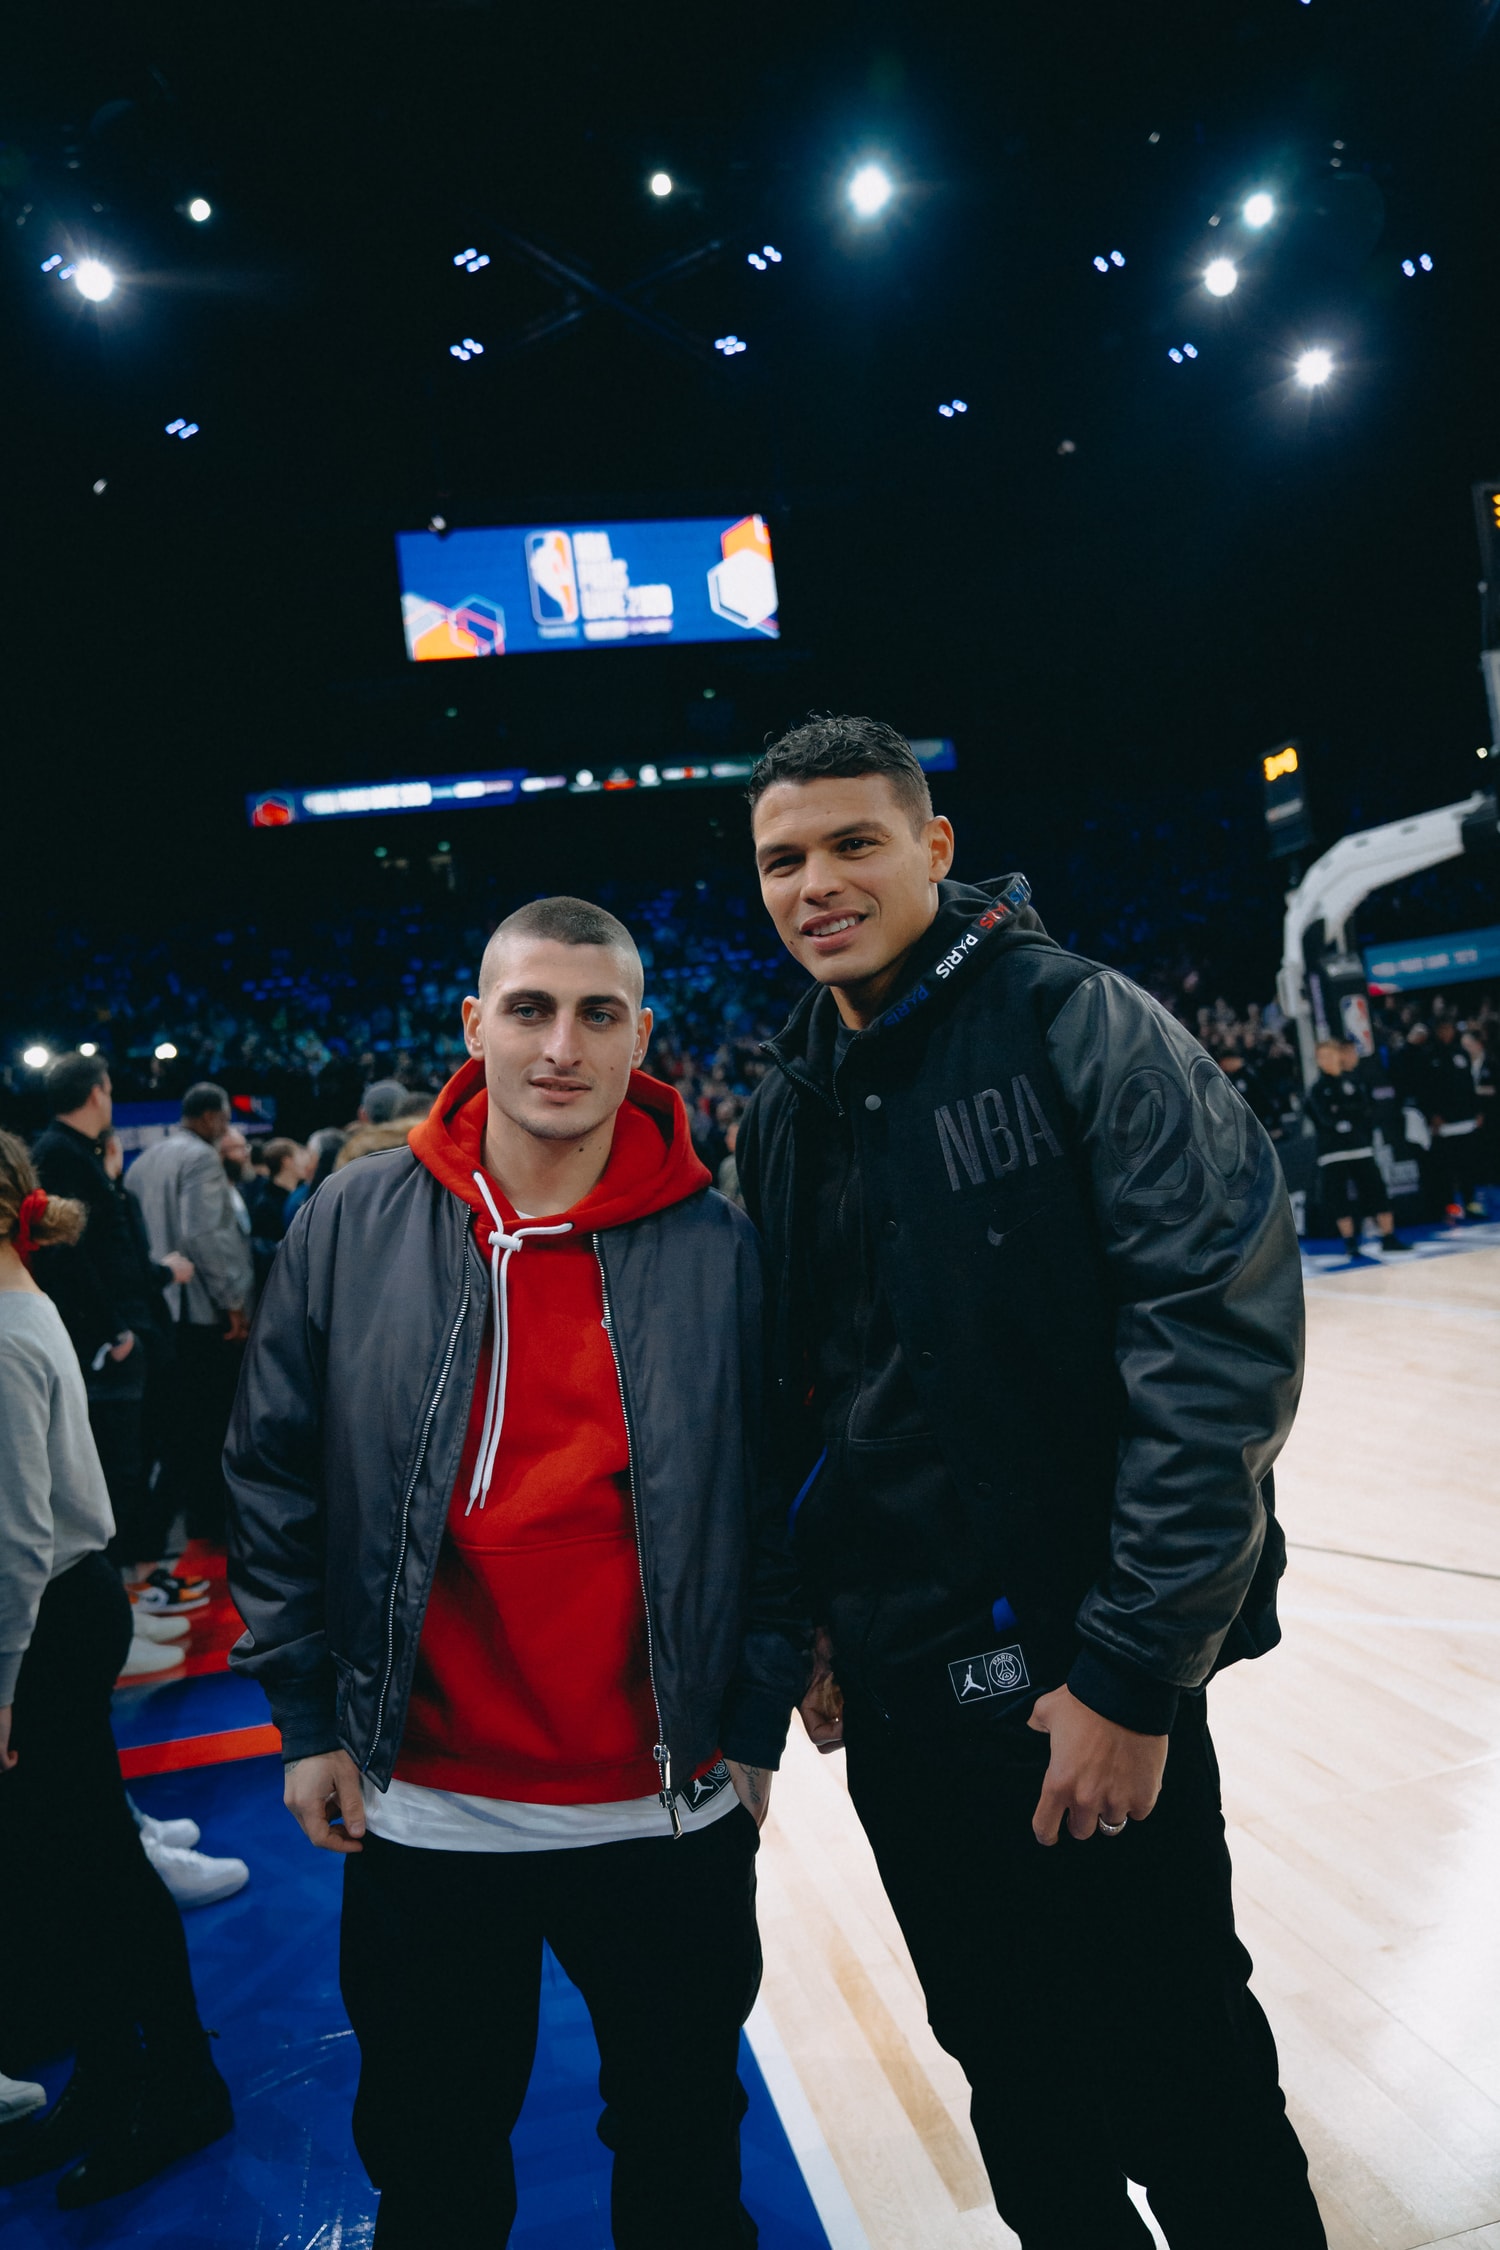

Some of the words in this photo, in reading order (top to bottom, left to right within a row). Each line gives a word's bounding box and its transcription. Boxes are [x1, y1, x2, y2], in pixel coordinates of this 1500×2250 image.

[935, 933, 979, 980] PARIS
[883, 984, 929, 1027] PARIS
[934, 1073, 1065, 1192] NBA
[1107, 1055, 1261, 1228] 20
[992, 1654, 1014, 1666] PARIS
